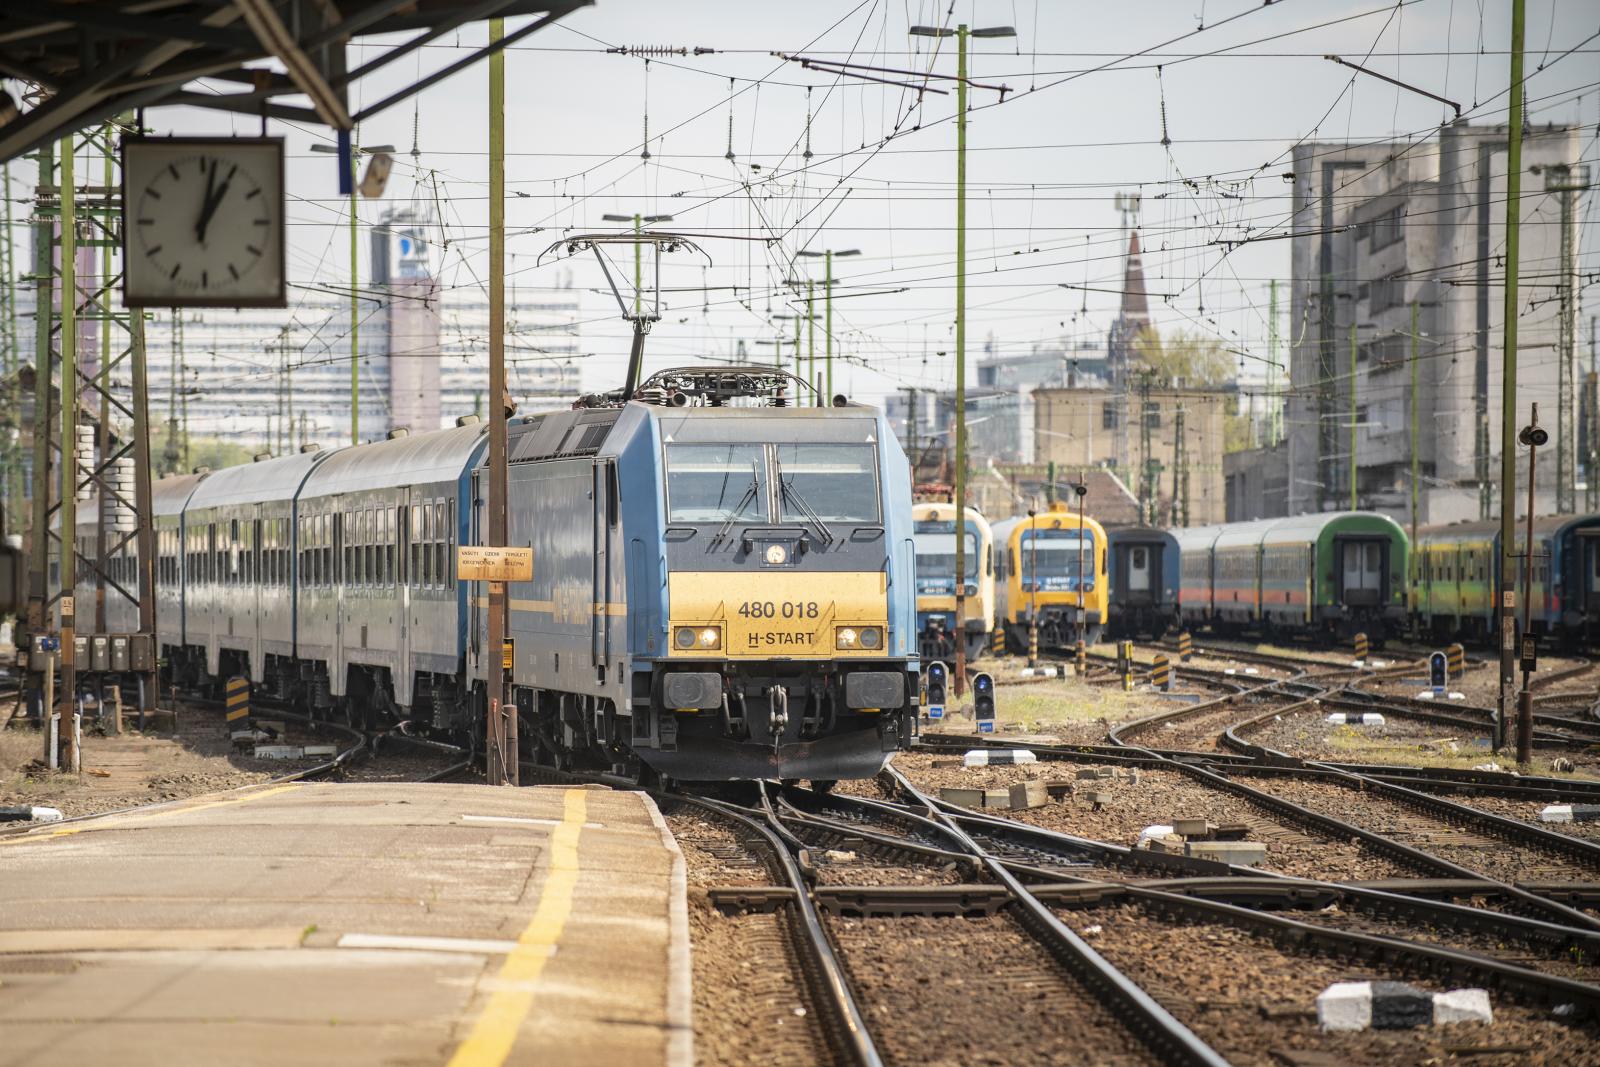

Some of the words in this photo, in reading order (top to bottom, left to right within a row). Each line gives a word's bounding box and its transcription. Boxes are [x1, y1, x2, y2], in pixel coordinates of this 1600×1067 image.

[738, 601, 775, 618] 480
[782, 601, 819, 618] 018
[748, 632, 815, 648] H-START
